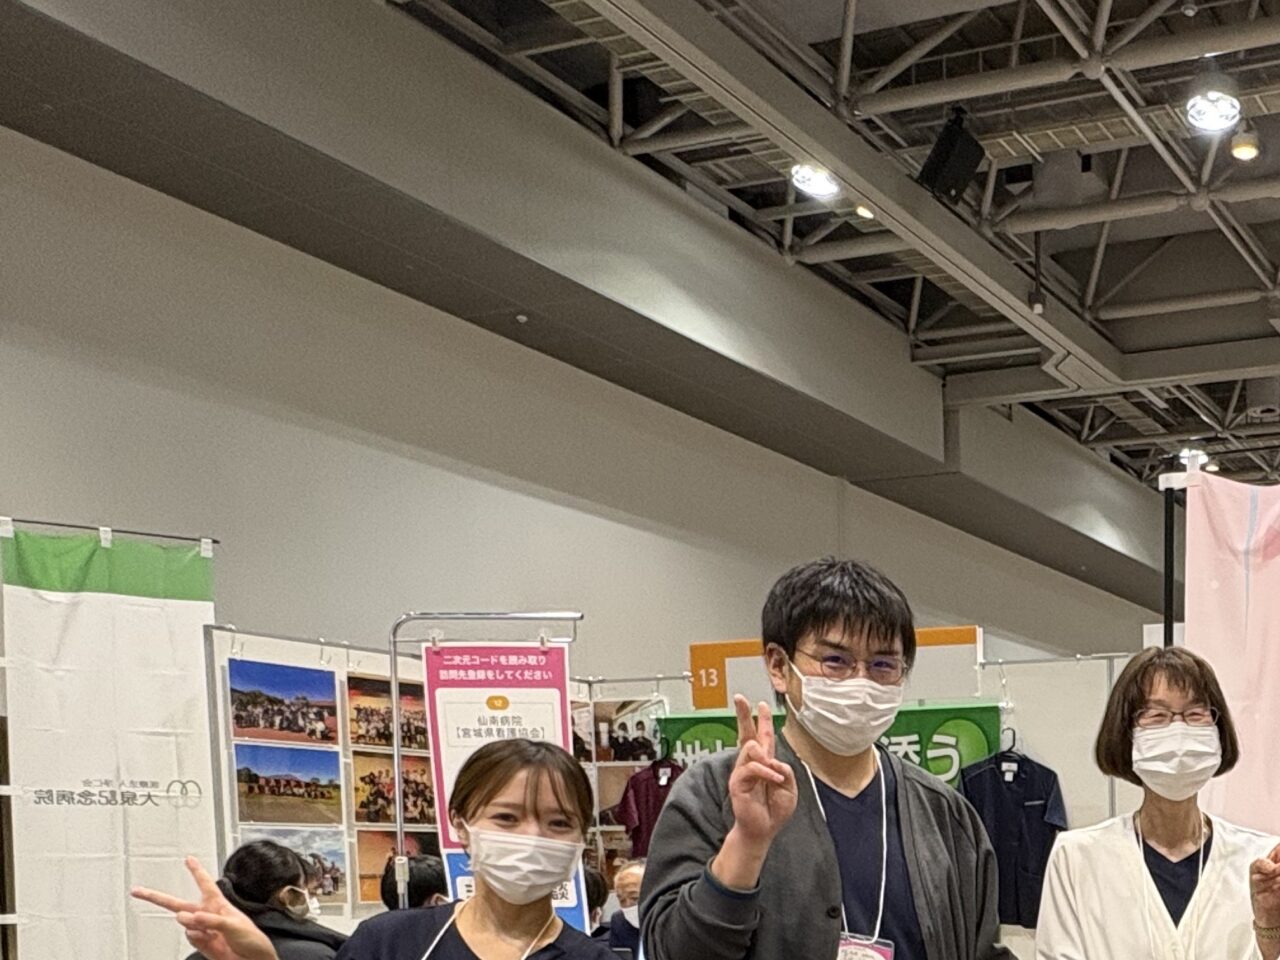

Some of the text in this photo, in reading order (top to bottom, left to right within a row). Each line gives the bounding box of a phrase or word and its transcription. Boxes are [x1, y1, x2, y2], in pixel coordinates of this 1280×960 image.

[699, 669, 718, 687] 13
[477, 715, 523, 726] 仙南病院
